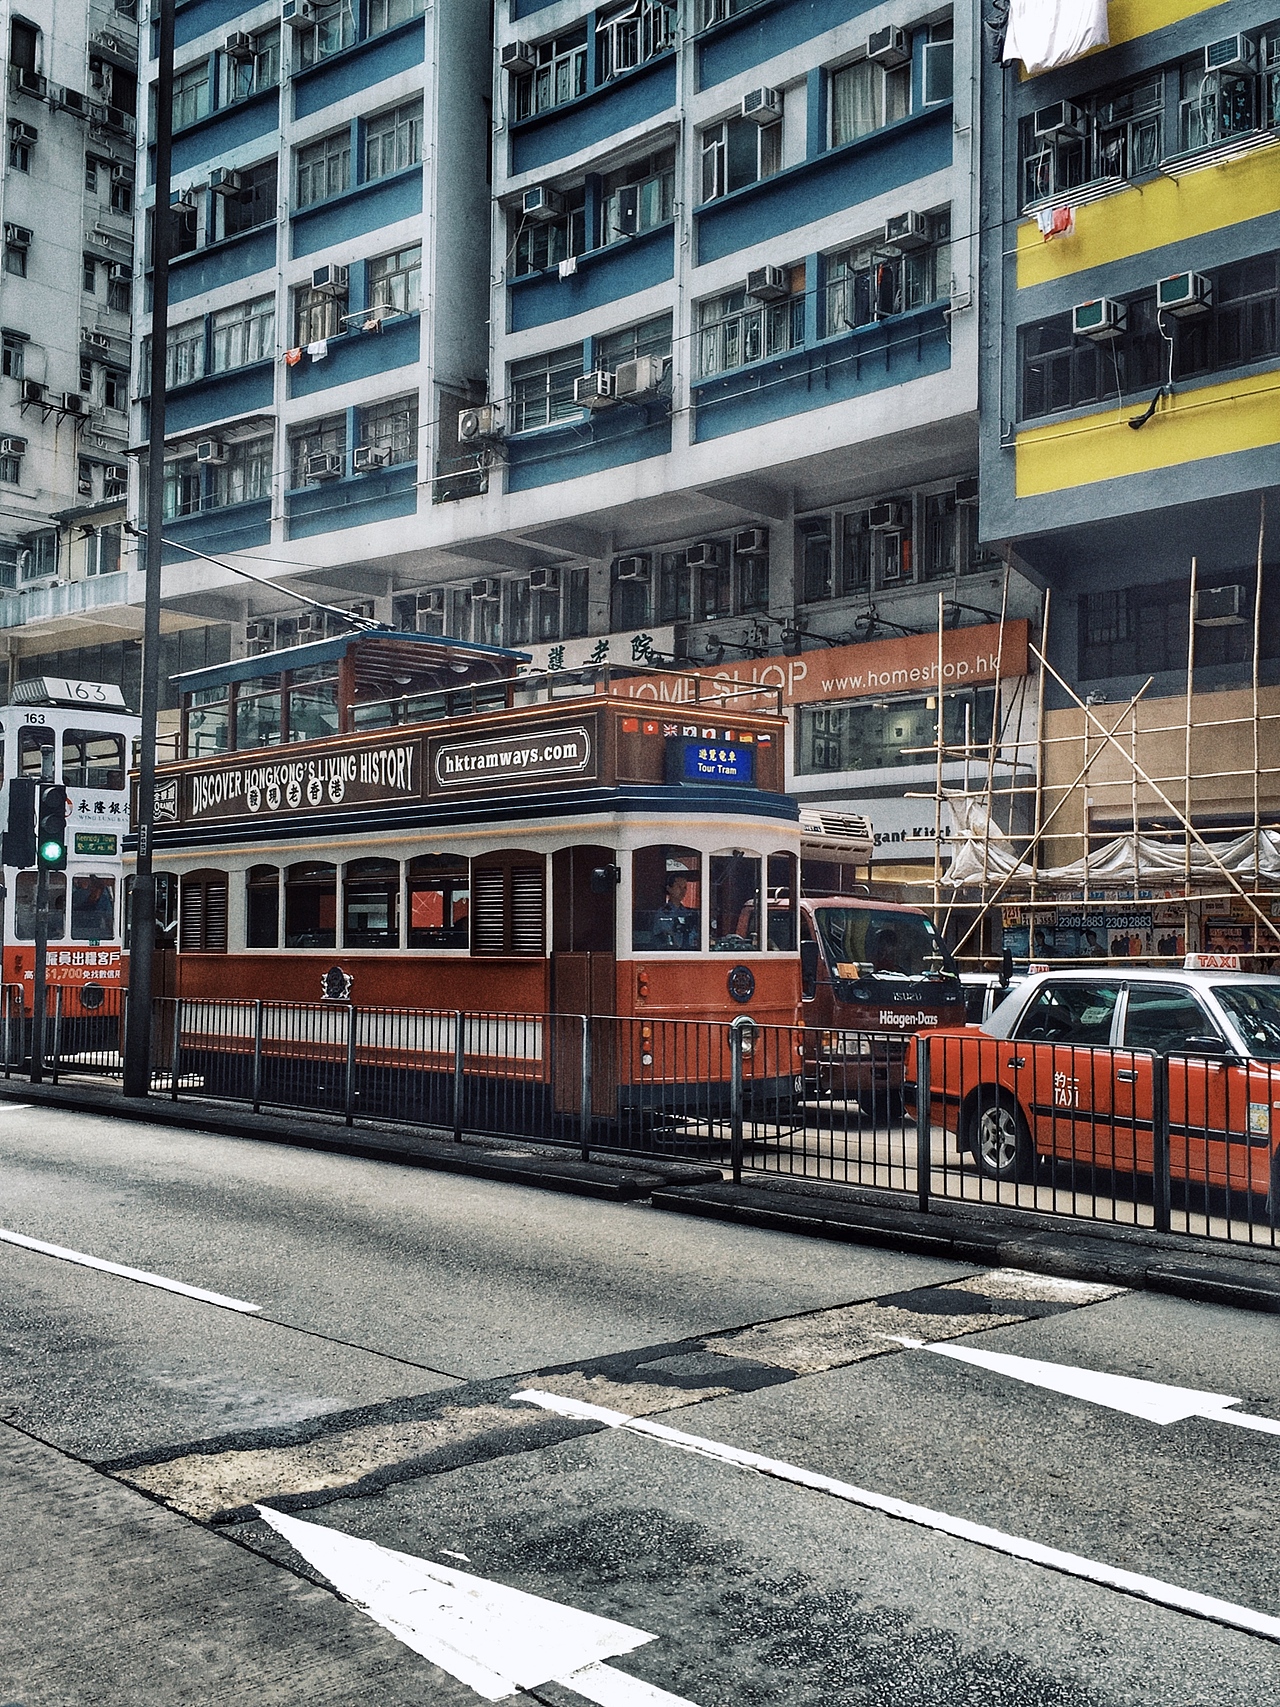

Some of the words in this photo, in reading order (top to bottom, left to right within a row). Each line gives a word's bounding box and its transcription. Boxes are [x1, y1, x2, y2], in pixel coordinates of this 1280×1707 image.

[822, 654, 1000, 692] www.homeshop.hk
[65, 682, 106, 701] 163
[713, 662, 807, 705] SHOP
[24, 713, 45, 724] 163
[445, 743, 577, 773] hktramways.com
[697, 762, 716, 773] Tour
[717, 764, 737, 775] Tram
[193, 771, 242, 816] DISCOVER
[244, 760, 316, 794] HONGKONG'S
[318, 754, 357, 782] LIVING
[360, 746, 414, 791] HISTORY
[249, 778, 342, 807] 發現老香港
[873, 829, 907, 847] gant
[1059, 916, 1081, 927] 2309
[1081, 915, 1104, 927] 2883
[1105, 916, 1129, 928] 2309
[1129, 915, 1152, 927] 2883
[1198, 955, 1237, 968] TAXI
[893, 991, 922, 1001] ISUZU
